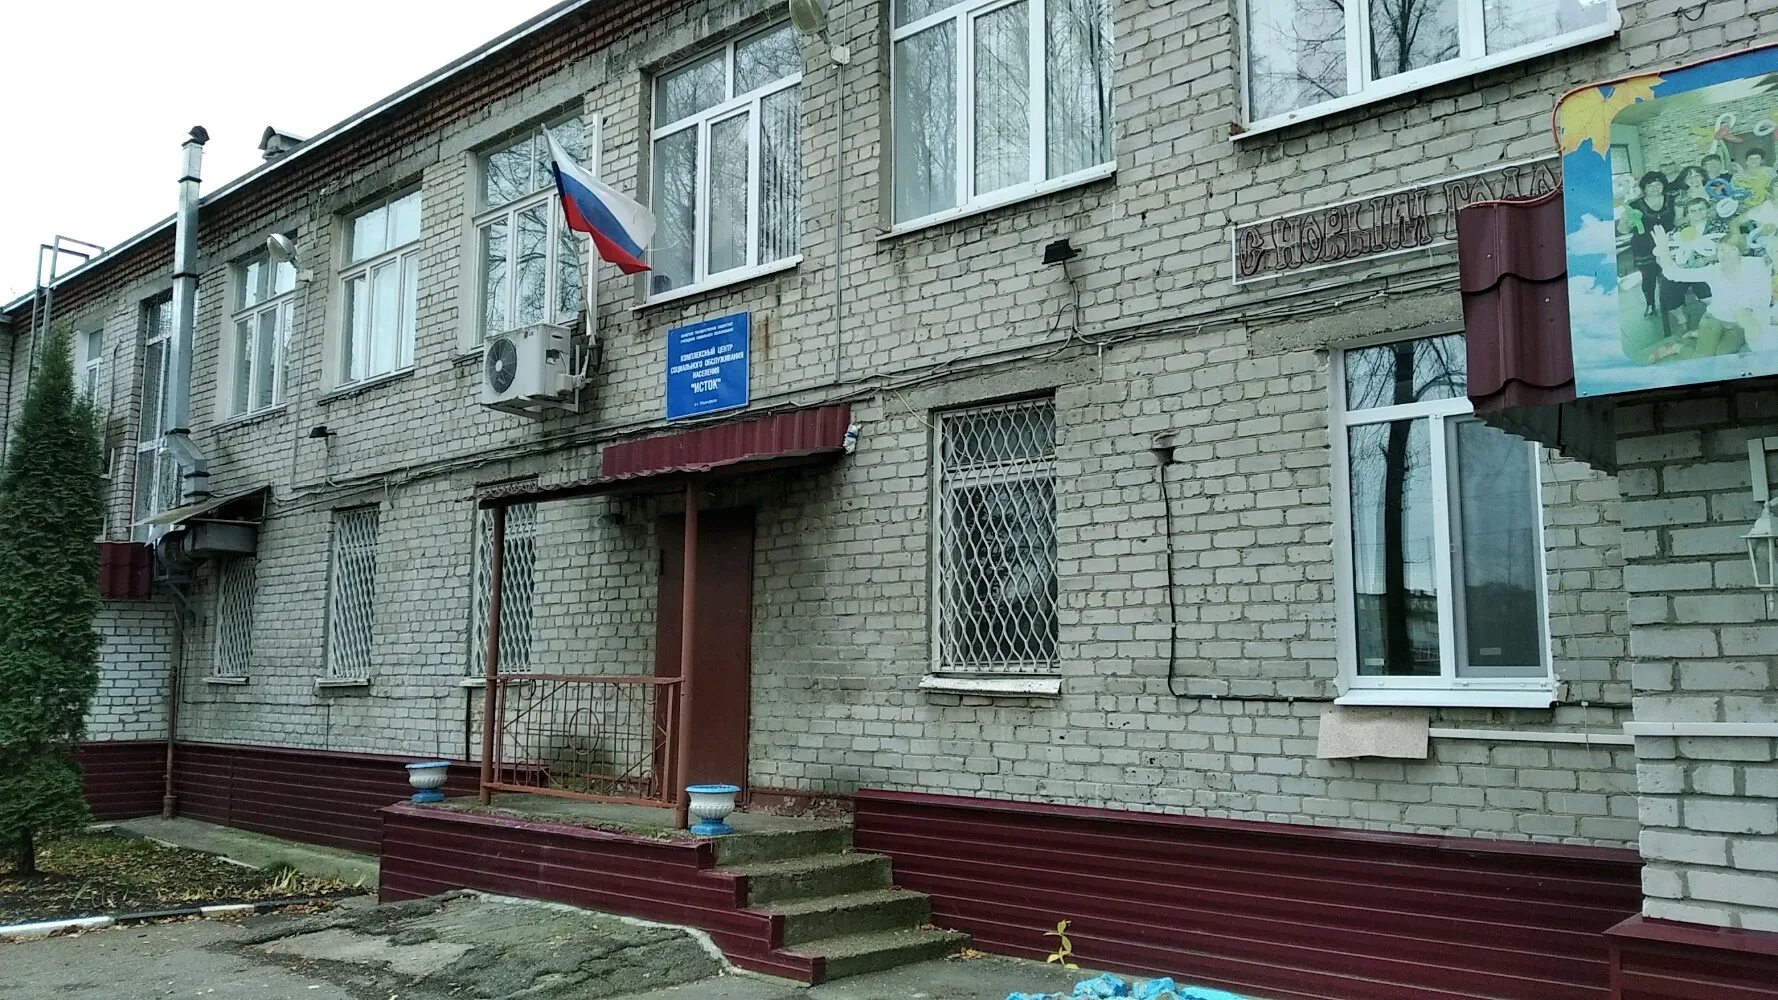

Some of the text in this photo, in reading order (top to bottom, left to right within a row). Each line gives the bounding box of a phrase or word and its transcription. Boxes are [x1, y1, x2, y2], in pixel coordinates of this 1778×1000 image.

[1271, 188, 1433, 271] НОВЫМ
[680, 343, 734, 362] КОМПЛЕКСНЫЙ ЦЕНТР
[670, 351, 744, 374] СОЦИАЛЬНОГО ОБСЛУЖИВАНИЯ
[692, 366, 720, 379] НАСЕЛЕНИЯ
[691, 378, 721, 393] "ИСТОК"
